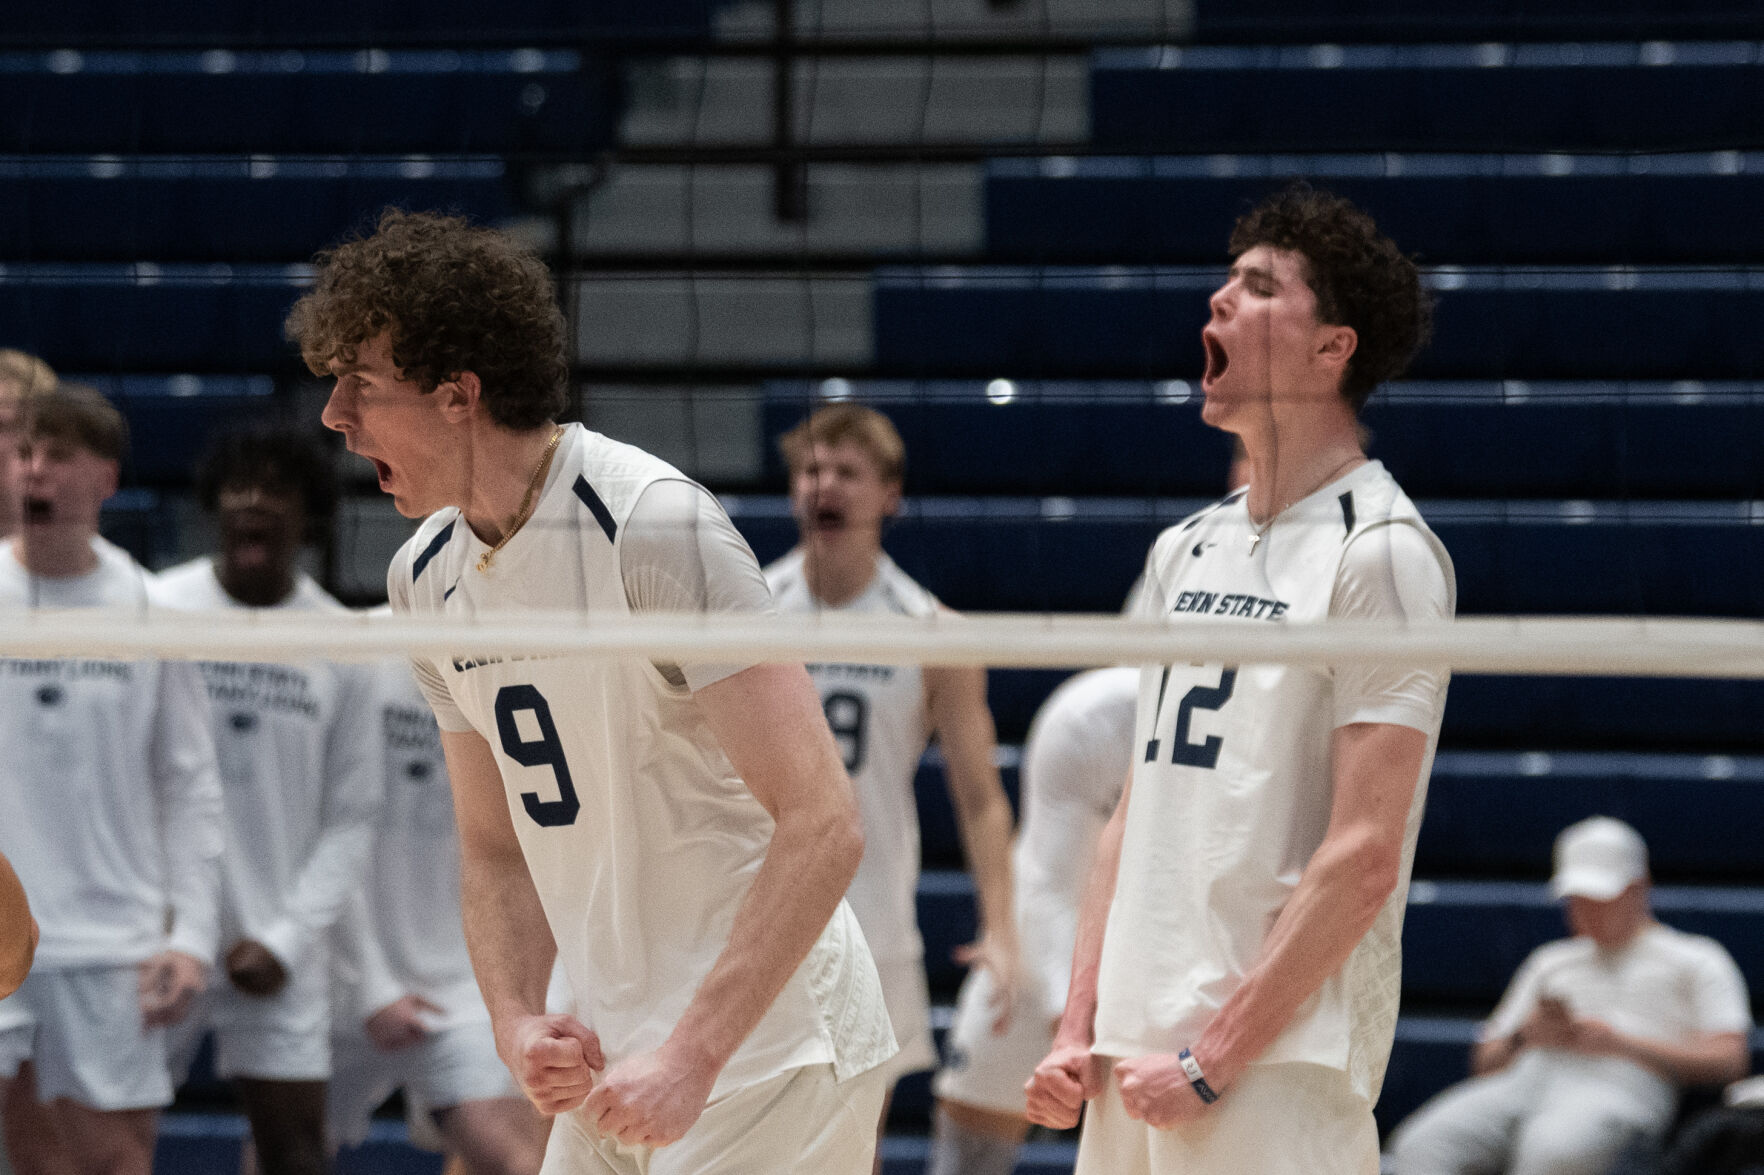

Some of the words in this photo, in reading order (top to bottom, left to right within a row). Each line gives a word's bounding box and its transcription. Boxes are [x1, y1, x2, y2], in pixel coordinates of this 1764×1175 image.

[1172, 590, 1219, 614] ENN
[1214, 593, 1290, 622] STATE
[494, 684, 581, 827] 9
[822, 688, 871, 776] 9
